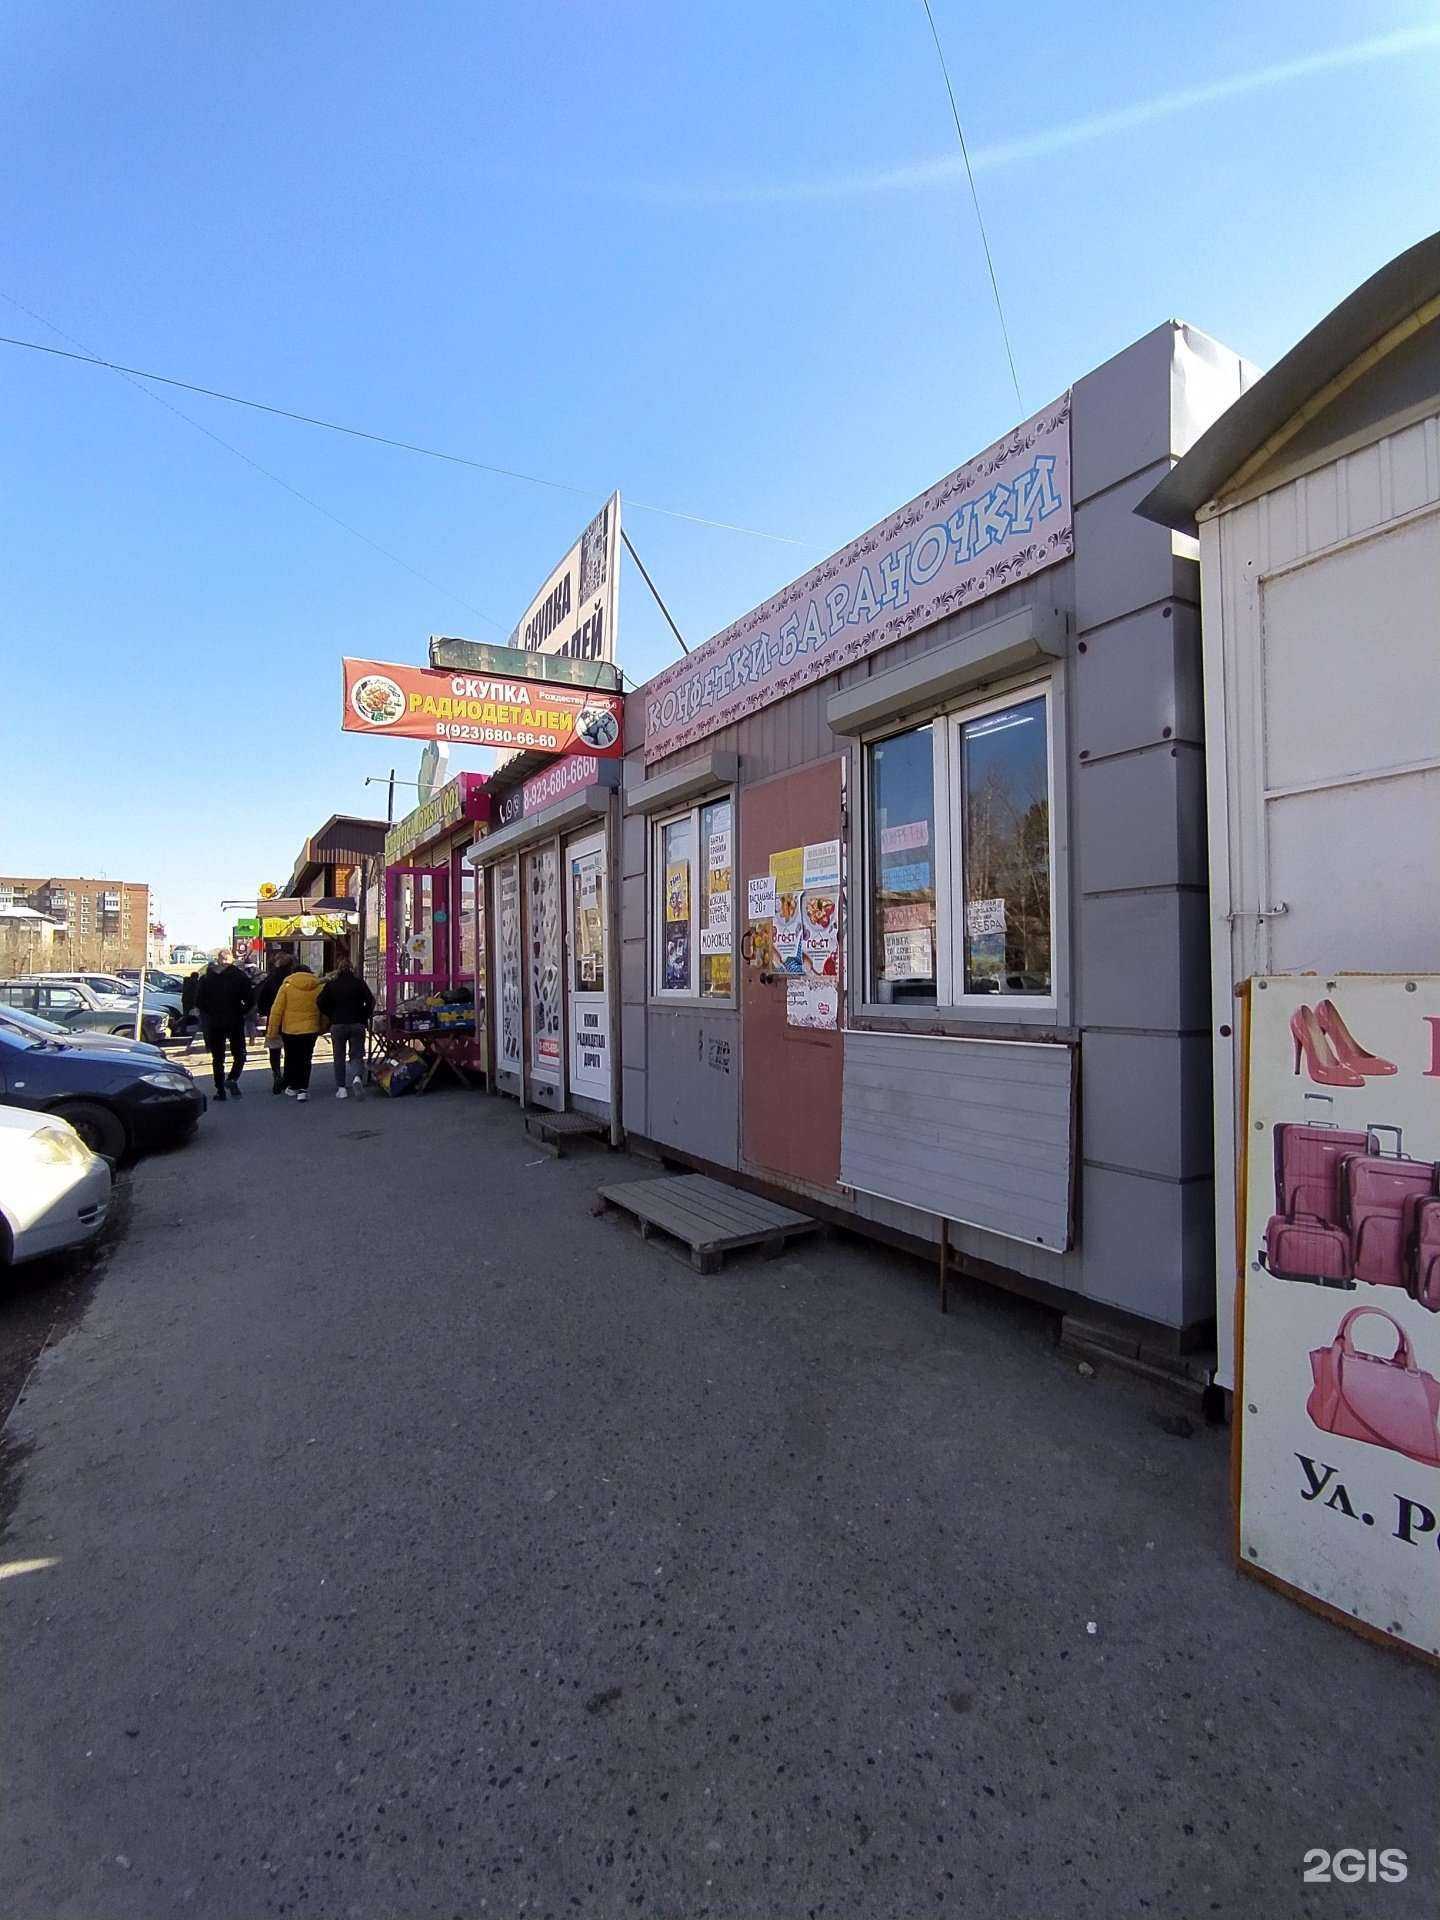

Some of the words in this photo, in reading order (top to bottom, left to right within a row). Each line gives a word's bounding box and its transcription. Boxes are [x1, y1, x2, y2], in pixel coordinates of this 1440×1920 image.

[525, 571, 571, 651] СКУПКА
[452, 677, 531, 704] СКУПКА
[409, 693, 573, 731] РАДИОДЕТАЛЕЙ
[436, 722, 557, 747] 8(923)680-66-60
[1294, 1452, 1375, 1526] Ул.
[1392, 1493, 1440, 1552] Р
